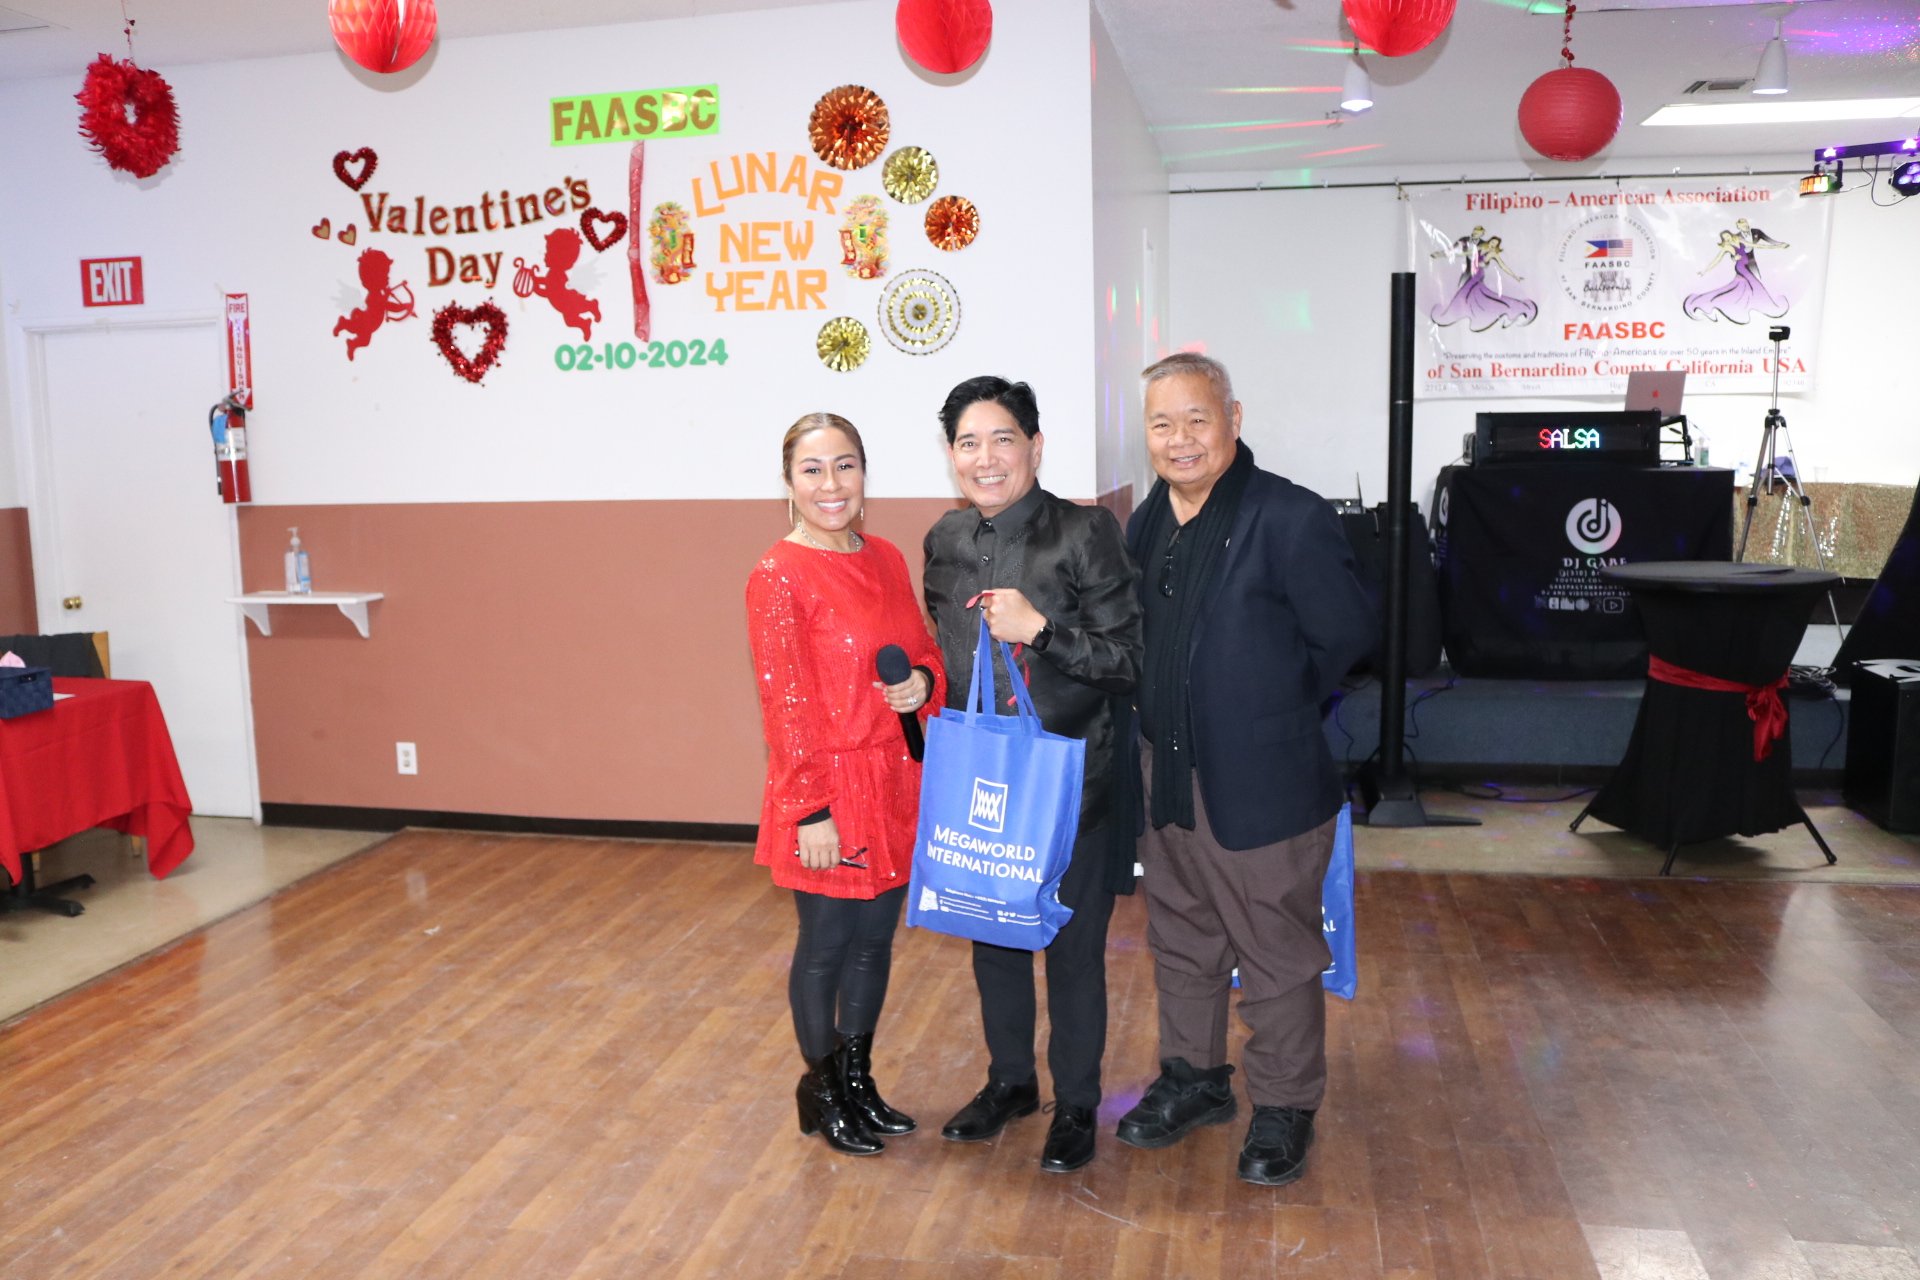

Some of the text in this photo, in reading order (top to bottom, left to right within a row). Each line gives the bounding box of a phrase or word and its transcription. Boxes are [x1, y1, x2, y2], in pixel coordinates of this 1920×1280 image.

[553, 90, 718, 142] FAASBC
[691, 152, 844, 218] LUNAR
[1466, 192, 1544, 214] Filipino
[1565, 190, 1657, 208] American
[1661, 186, 1771, 205] Association
[360, 176, 591, 236] Valentine's
[718, 220, 814, 263] NEW
[89, 261, 134, 303] EXIT
[425, 247, 503, 287] Day
[1584, 261, 1631, 269] FAASBC
[229, 304, 245, 313] FIRE
[705, 269, 828, 312] YEAR
[1581, 301, 1632, 311] BERNARDINO
[1637, 272, 1656, 300] COUNTY
[1563, 322, 1666, 340] FAASBC
[555, 339, 728, 371] 02-10-2024
[1428, 364, 1445, 379] of
[1450, 363, 1482, 378] San
[1491, 362, 1587, 378] Bernardino
[1666, 359, 1753, 375] California
[1762, 357, 1806, 374] USA
[1521, 351, 1536, 359] and
[1537, 351, 1568, 359] traditions
[1686, 347, 1699, 356] 50
[1701, 349, 1719, 358] years
[1729, 347, 1739, 355] the
[1741, 347, 1761, 355] Inland
[1539, 428, 1600, 449] SALSA
[1563, 558, 1580, 569] DJ
[934, 824, 1035, 862] MEGAWORLD
[927, 841, 1043, 884] INTERNATIONAL
